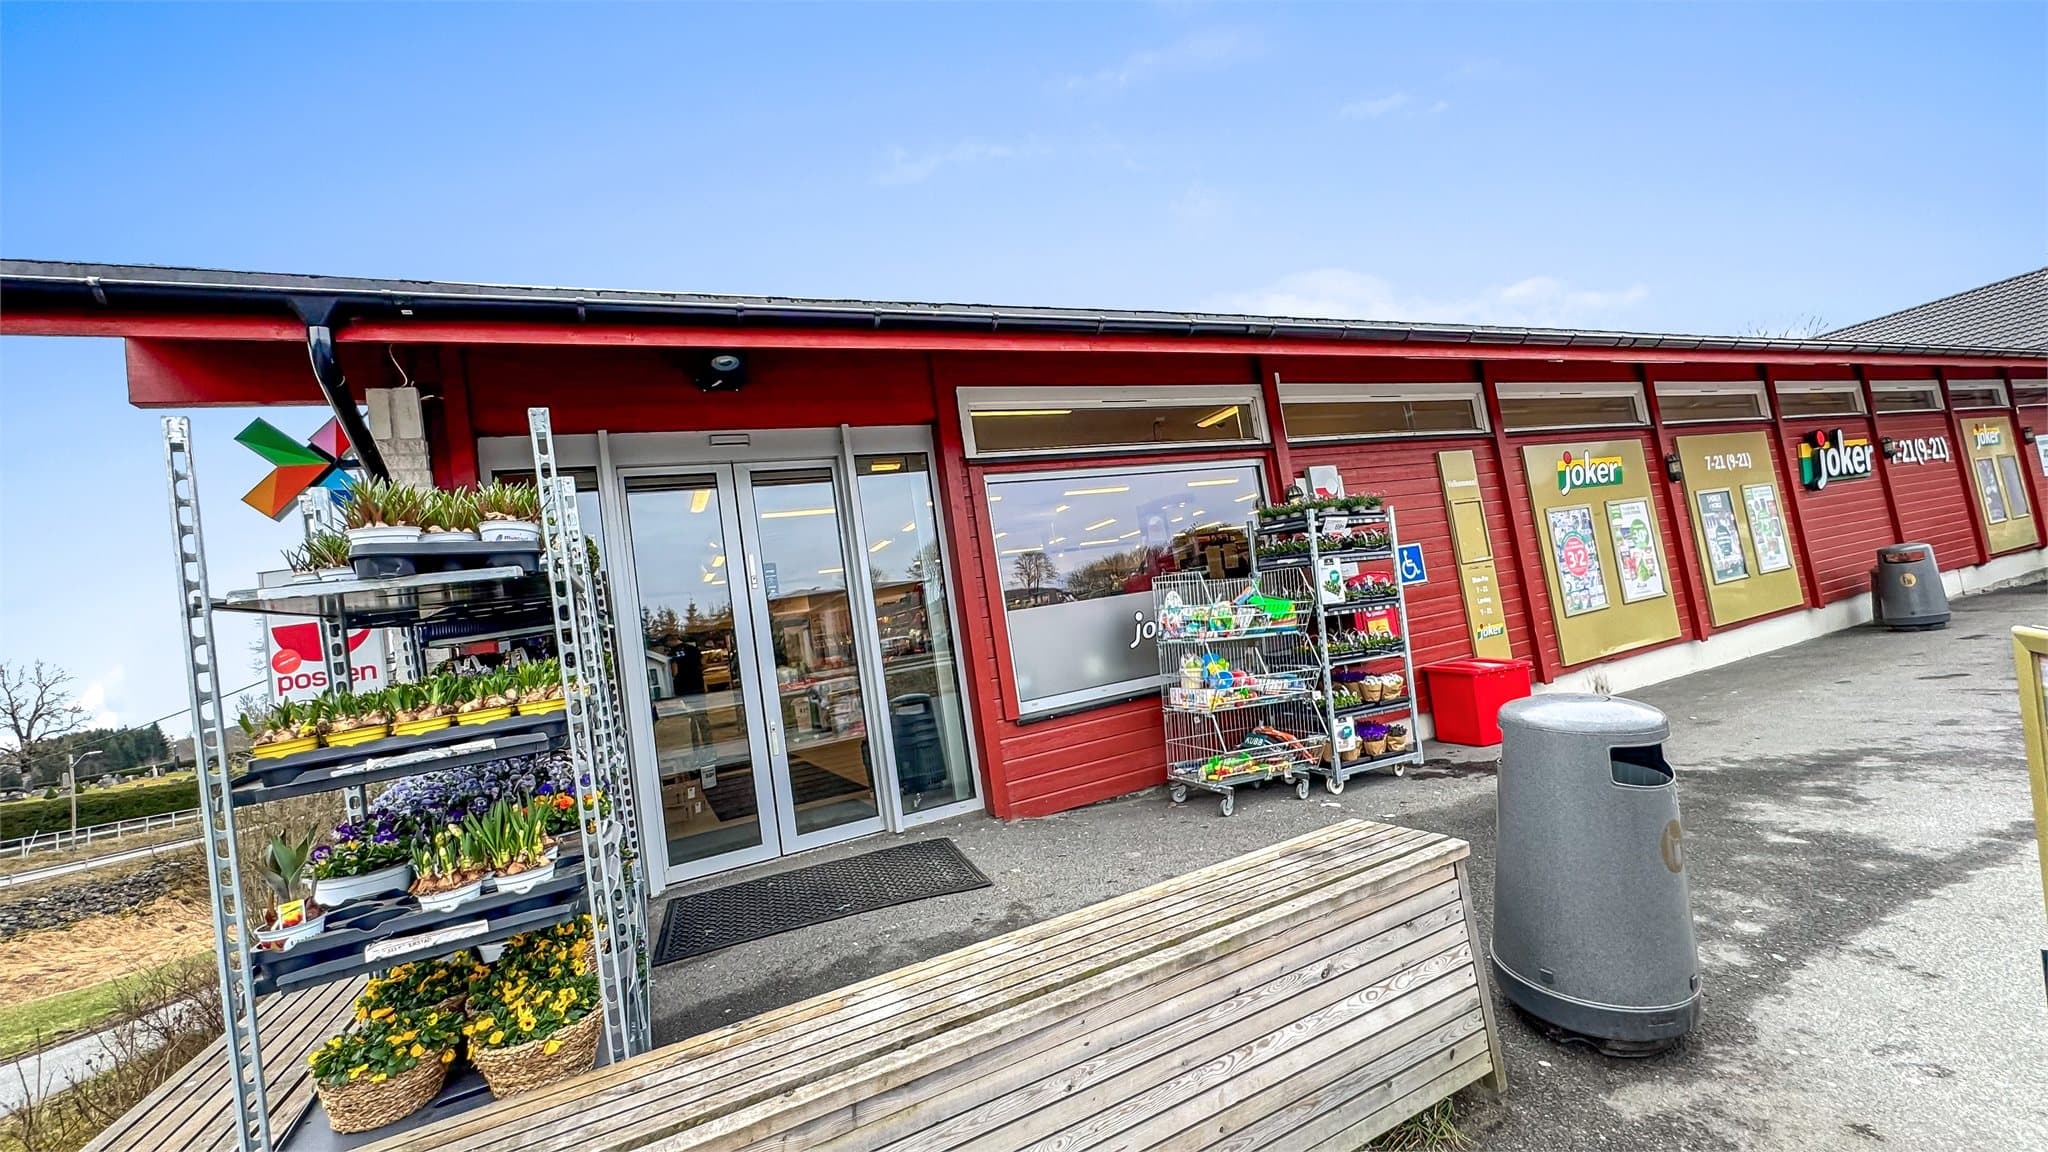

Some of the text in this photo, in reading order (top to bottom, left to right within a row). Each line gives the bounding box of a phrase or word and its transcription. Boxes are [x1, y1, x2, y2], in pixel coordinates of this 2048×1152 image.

[1974, 423, 2000, 450] joker
[1561, 450, 1618, 496] joker
[1816, 428, 1874, 490] joker
[1129, 611, 1161, 649] jo
[1478, 623, 1502, 640] joker
[277, 665, 377, 697] posen
[1244, 736, 1263, 746] KUBB
